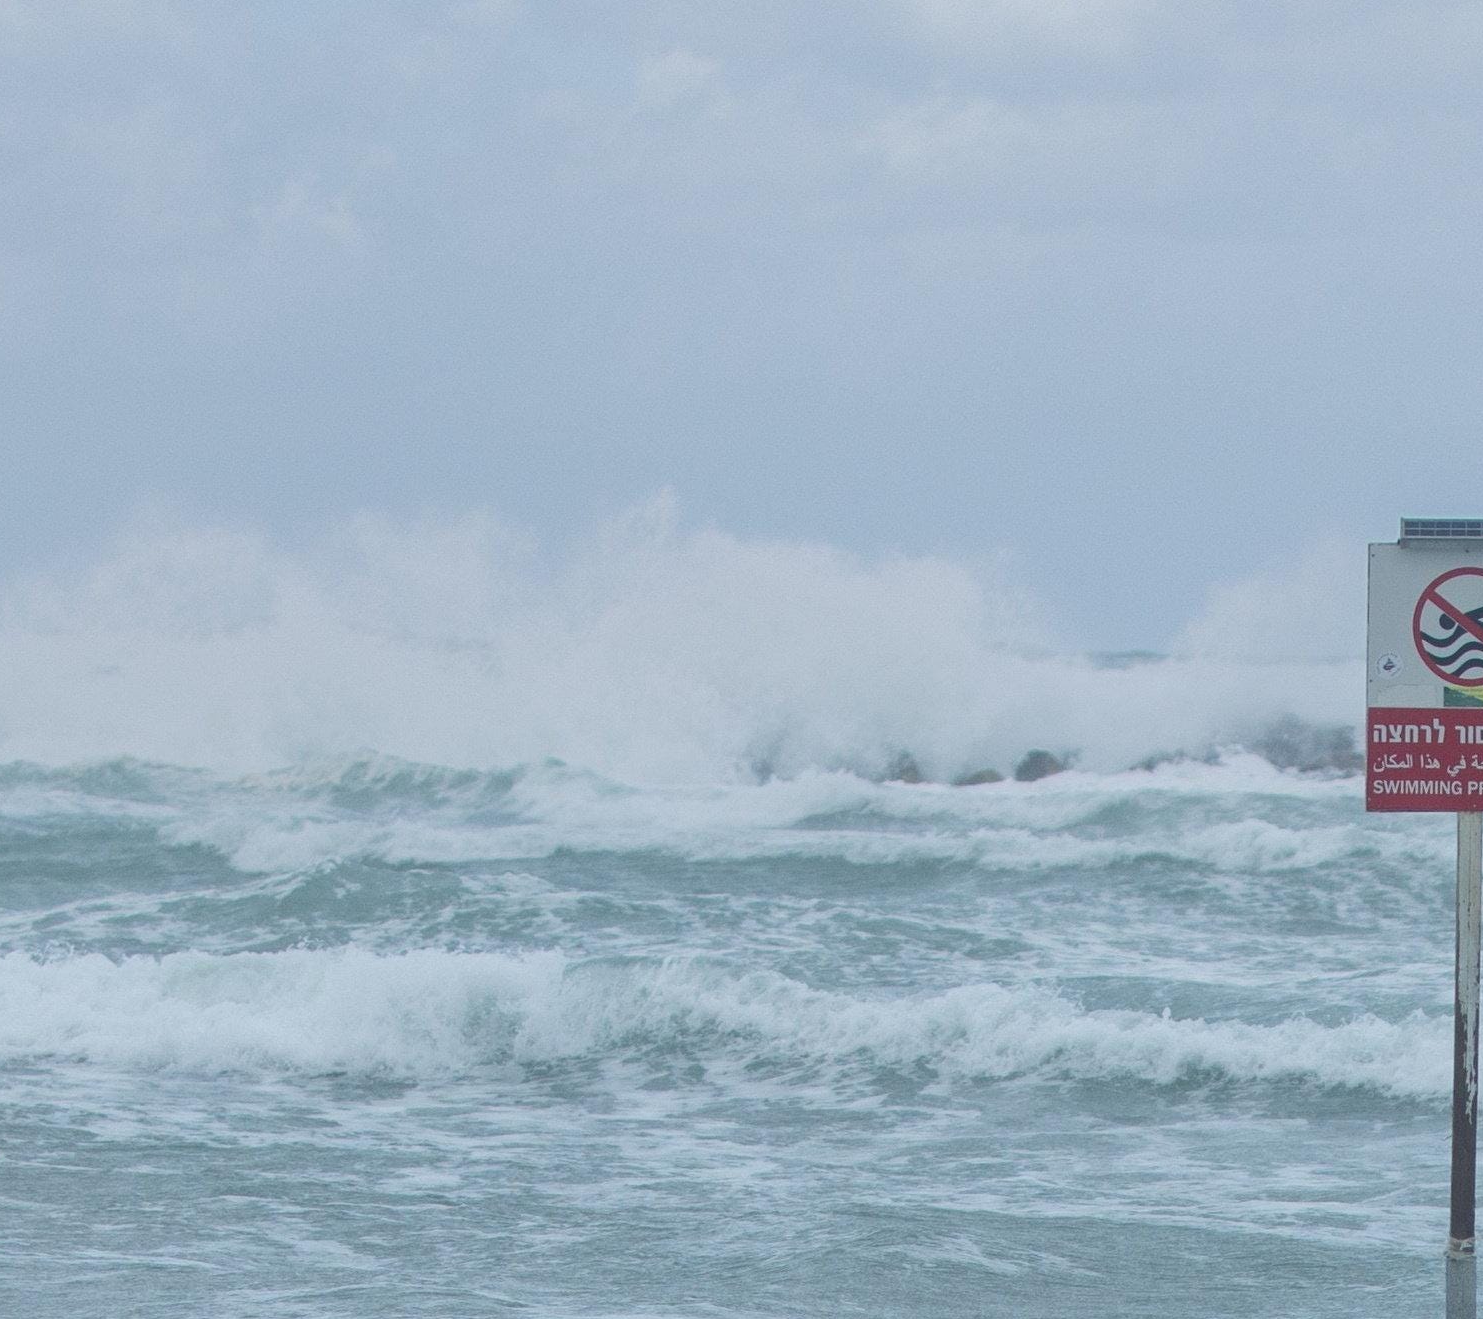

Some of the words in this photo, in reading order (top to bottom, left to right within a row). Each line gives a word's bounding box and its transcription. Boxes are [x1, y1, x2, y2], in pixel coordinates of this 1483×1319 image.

[1373, 718, 1446, 743] לרחצה
[1373, 753, 1413, 773] المكان
[1420, 753, 1441, 769] هذا
[1446, 754, 1467, 777] في
[1373, 780, 1463, 795] SWIMMING
